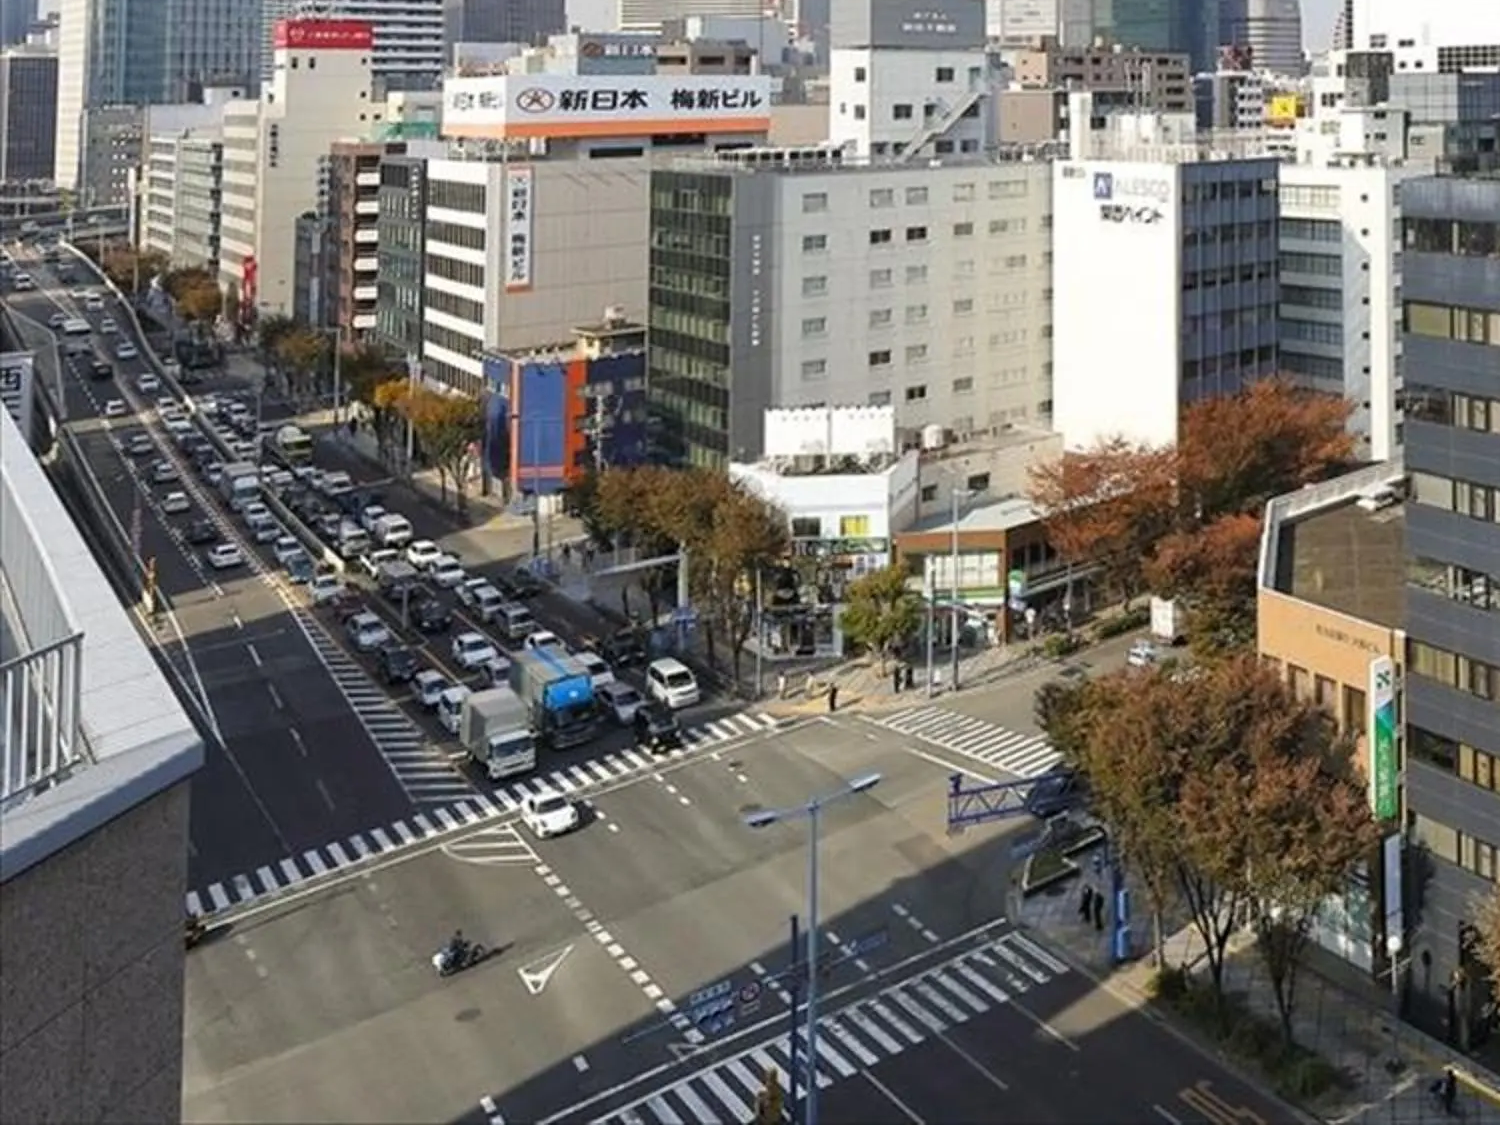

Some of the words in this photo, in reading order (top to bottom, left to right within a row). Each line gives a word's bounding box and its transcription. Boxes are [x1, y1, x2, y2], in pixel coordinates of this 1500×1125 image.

[559, 88, 648, 111] 新日本
[670, 88, 762, 110] 梅新ビル
